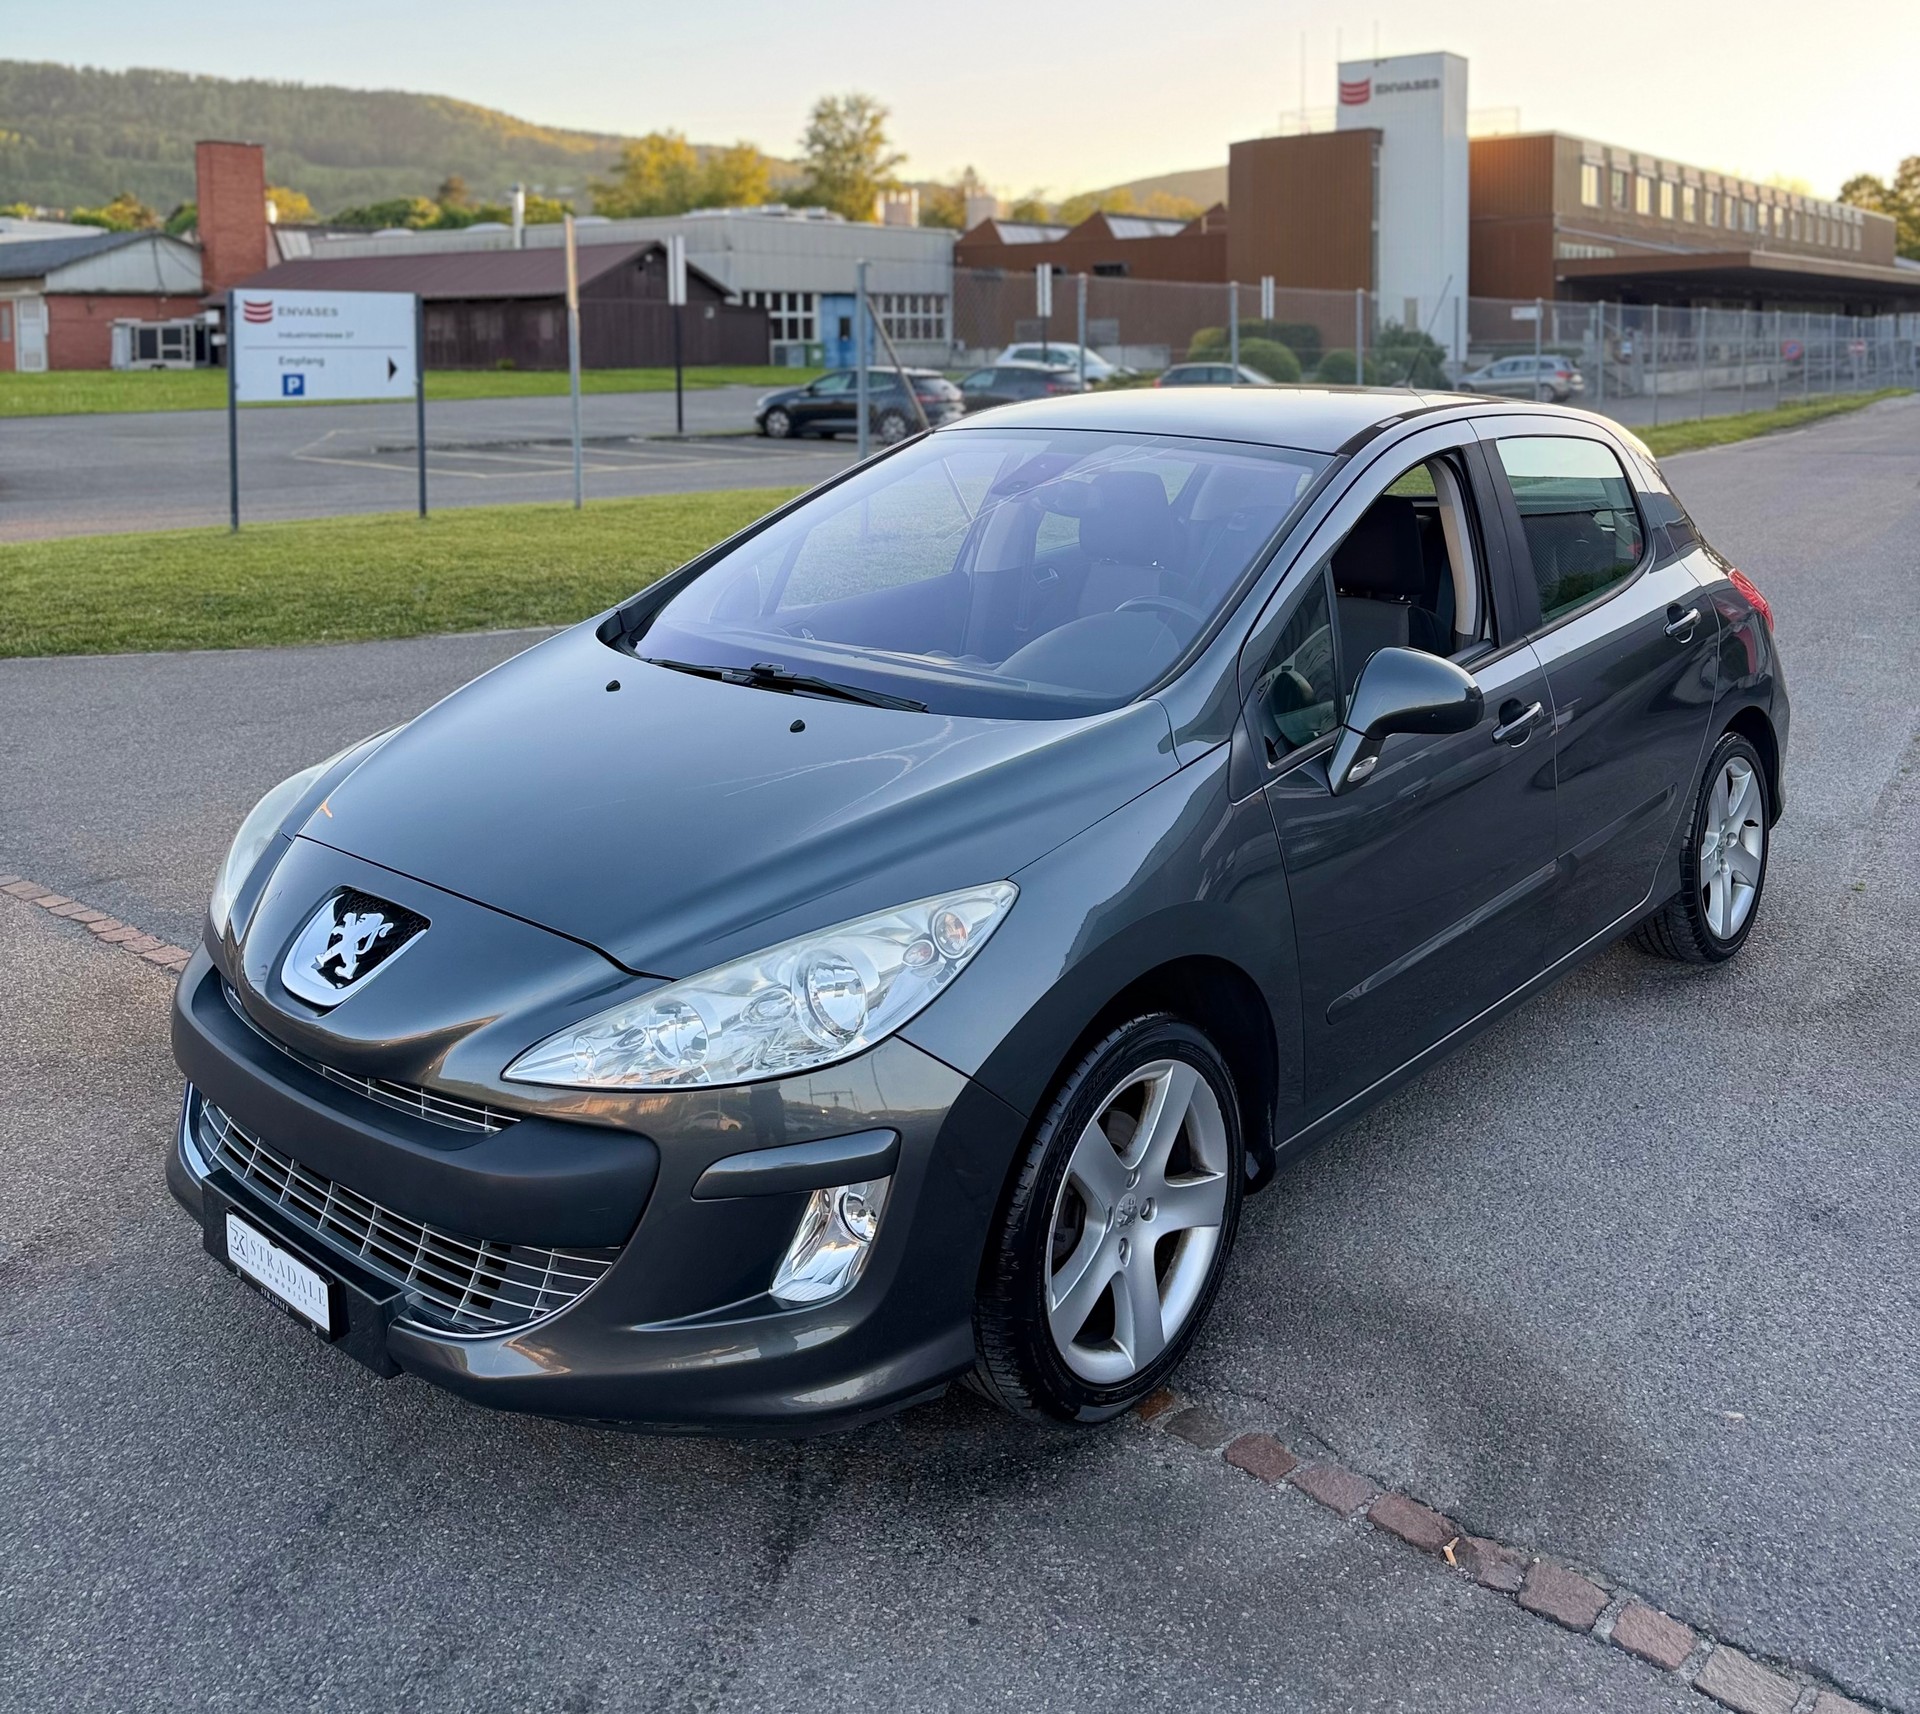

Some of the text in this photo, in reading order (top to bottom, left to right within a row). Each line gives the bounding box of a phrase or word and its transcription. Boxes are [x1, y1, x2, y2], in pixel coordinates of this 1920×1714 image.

[278, 307, 339, 317] ENVASES
[278, 356, 325, 367] Empfang
[287, 376, 301, 393] P
[250, 1239, 326, 1307] STRADALE
